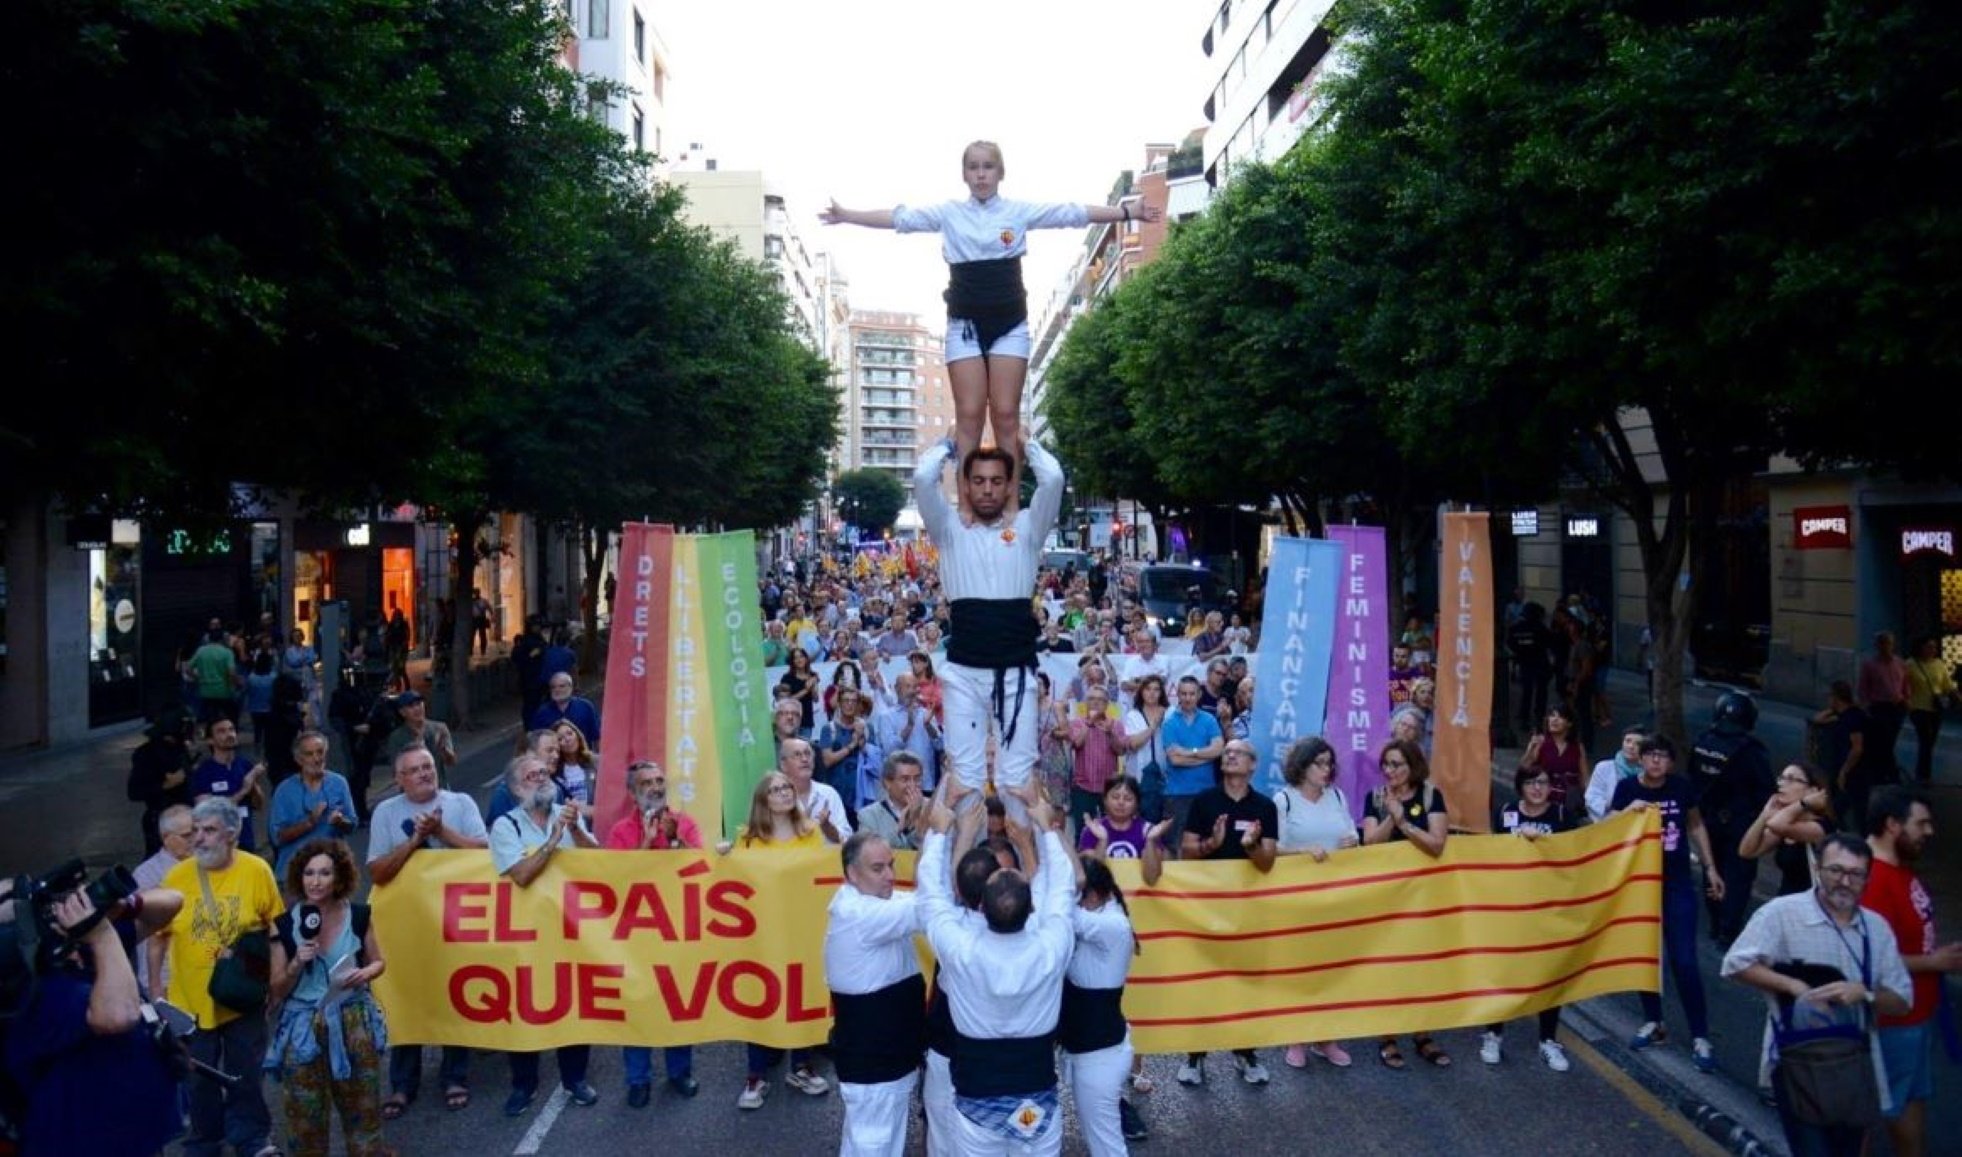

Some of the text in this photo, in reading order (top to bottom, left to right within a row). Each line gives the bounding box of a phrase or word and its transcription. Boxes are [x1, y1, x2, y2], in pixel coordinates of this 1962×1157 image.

[1568, 520, 1598, 536] LUSH
[1802, 517, 1847, 536] CAMPER
[1902, 531, 1954, 555] CAMPER
[630, 555, 654, 678] DRETS
[721, 562, 756, 748] ECOLOGIA
[1346, 554, 1370, 750] FEMINISME
[675, 564, 698, 803] LLIBERTATS
[443, 859, 757, 943] EL PAÍS
[448, 959, 836, 1026] QUE VOL
